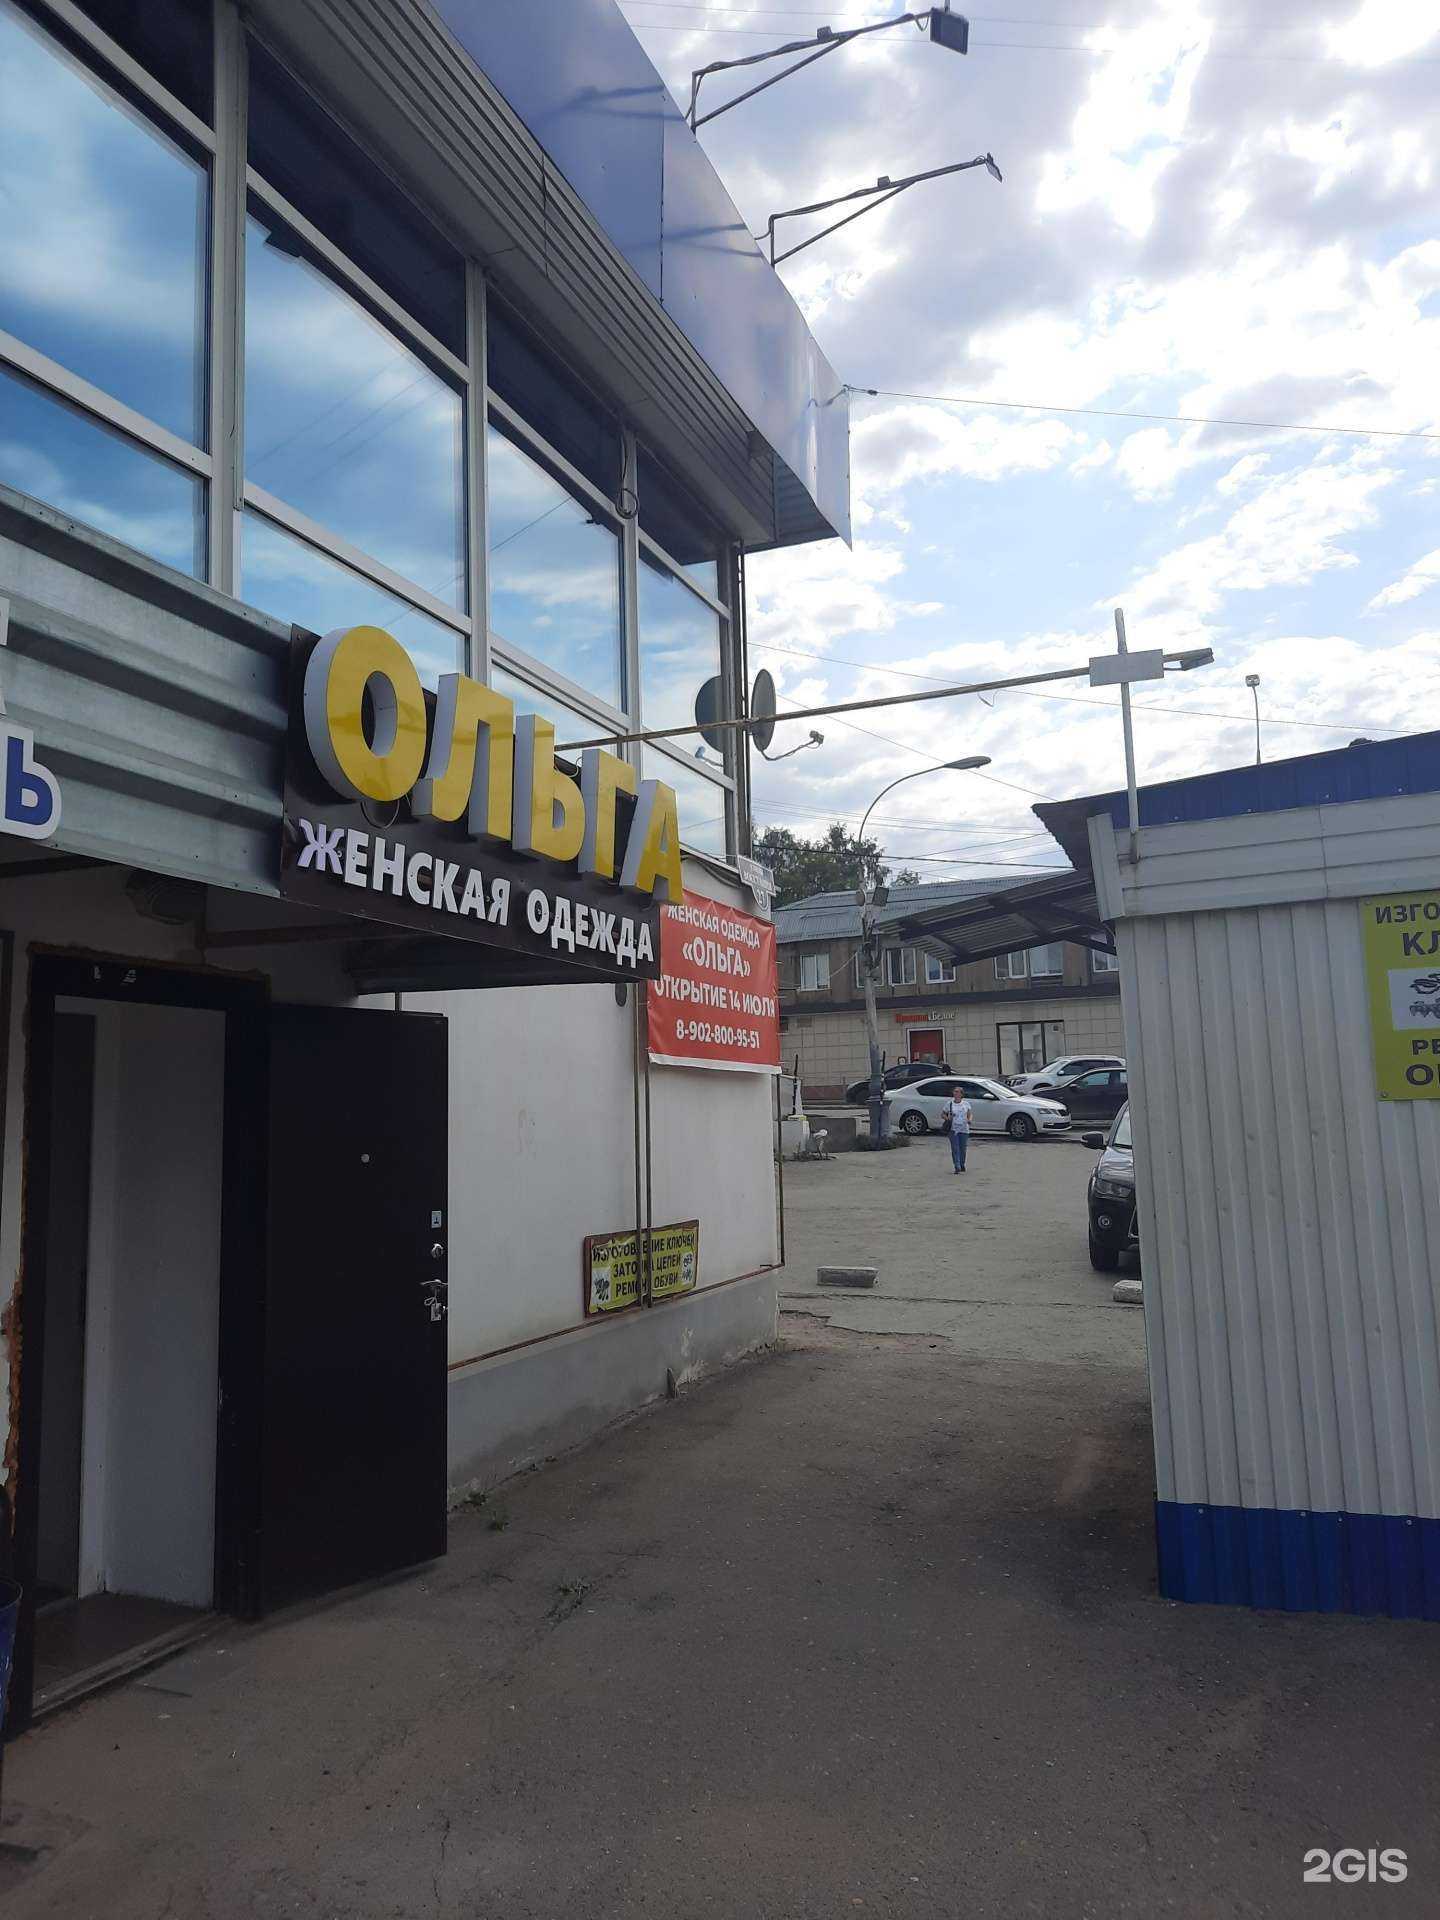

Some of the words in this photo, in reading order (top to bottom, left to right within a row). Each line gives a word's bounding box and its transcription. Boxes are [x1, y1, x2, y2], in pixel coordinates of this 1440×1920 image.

[304, 626, 683, 904] ОЛЬГА
[297, 818, 511, 926] ЖЕНСКАЯ
[527, 888, 655, 969] ОДЕЖДА
[1375, 902, 1440, 924] ИЗГО
[667, 903, 719, 934] ЖЕНСКАЯ
[721, 919, 761, 949] ОДЕЖДА
[682, 936, 751, 978] «ОЛЬГА»
[654, 974, 728, 1009] ОТКРЫТИЕ
[729, 989, 740, 1012] 14
[742, 993, 776, 1018] ИЮЛЯ
[676, 1018, 760, 1050] 8-902-800-95-51
